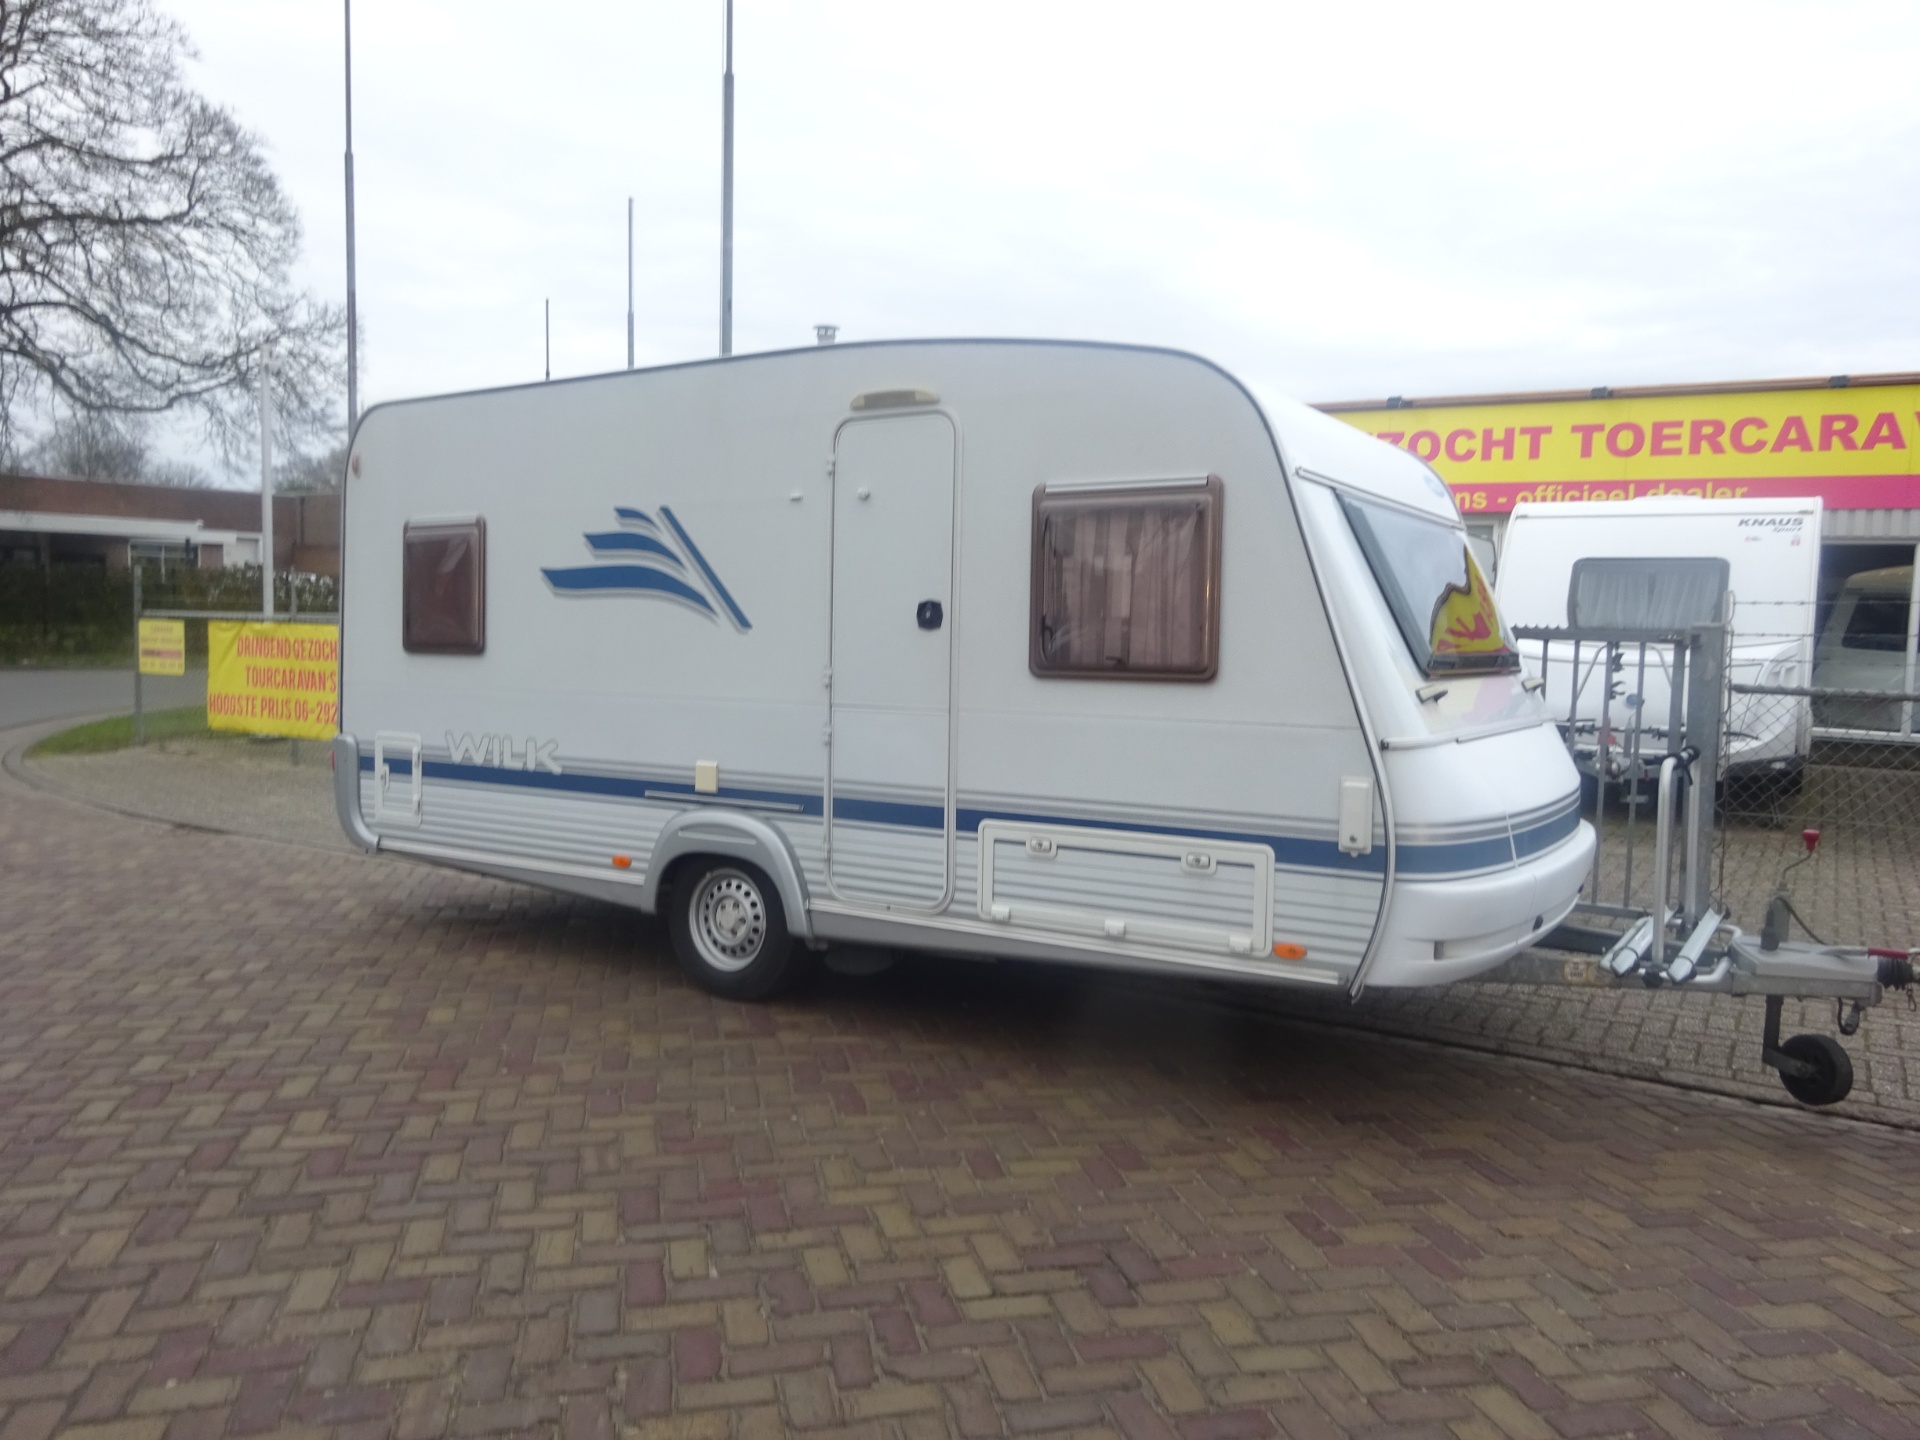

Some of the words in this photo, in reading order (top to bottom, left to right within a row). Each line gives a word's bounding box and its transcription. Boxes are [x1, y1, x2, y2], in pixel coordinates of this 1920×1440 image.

[1570, 411, 1920, 459] TOERCARA
[1738, 517, 1804, 527] KNAUS
[260, 695, 291, 721] PRIJS
[445, 729, 563, 776] WILK
